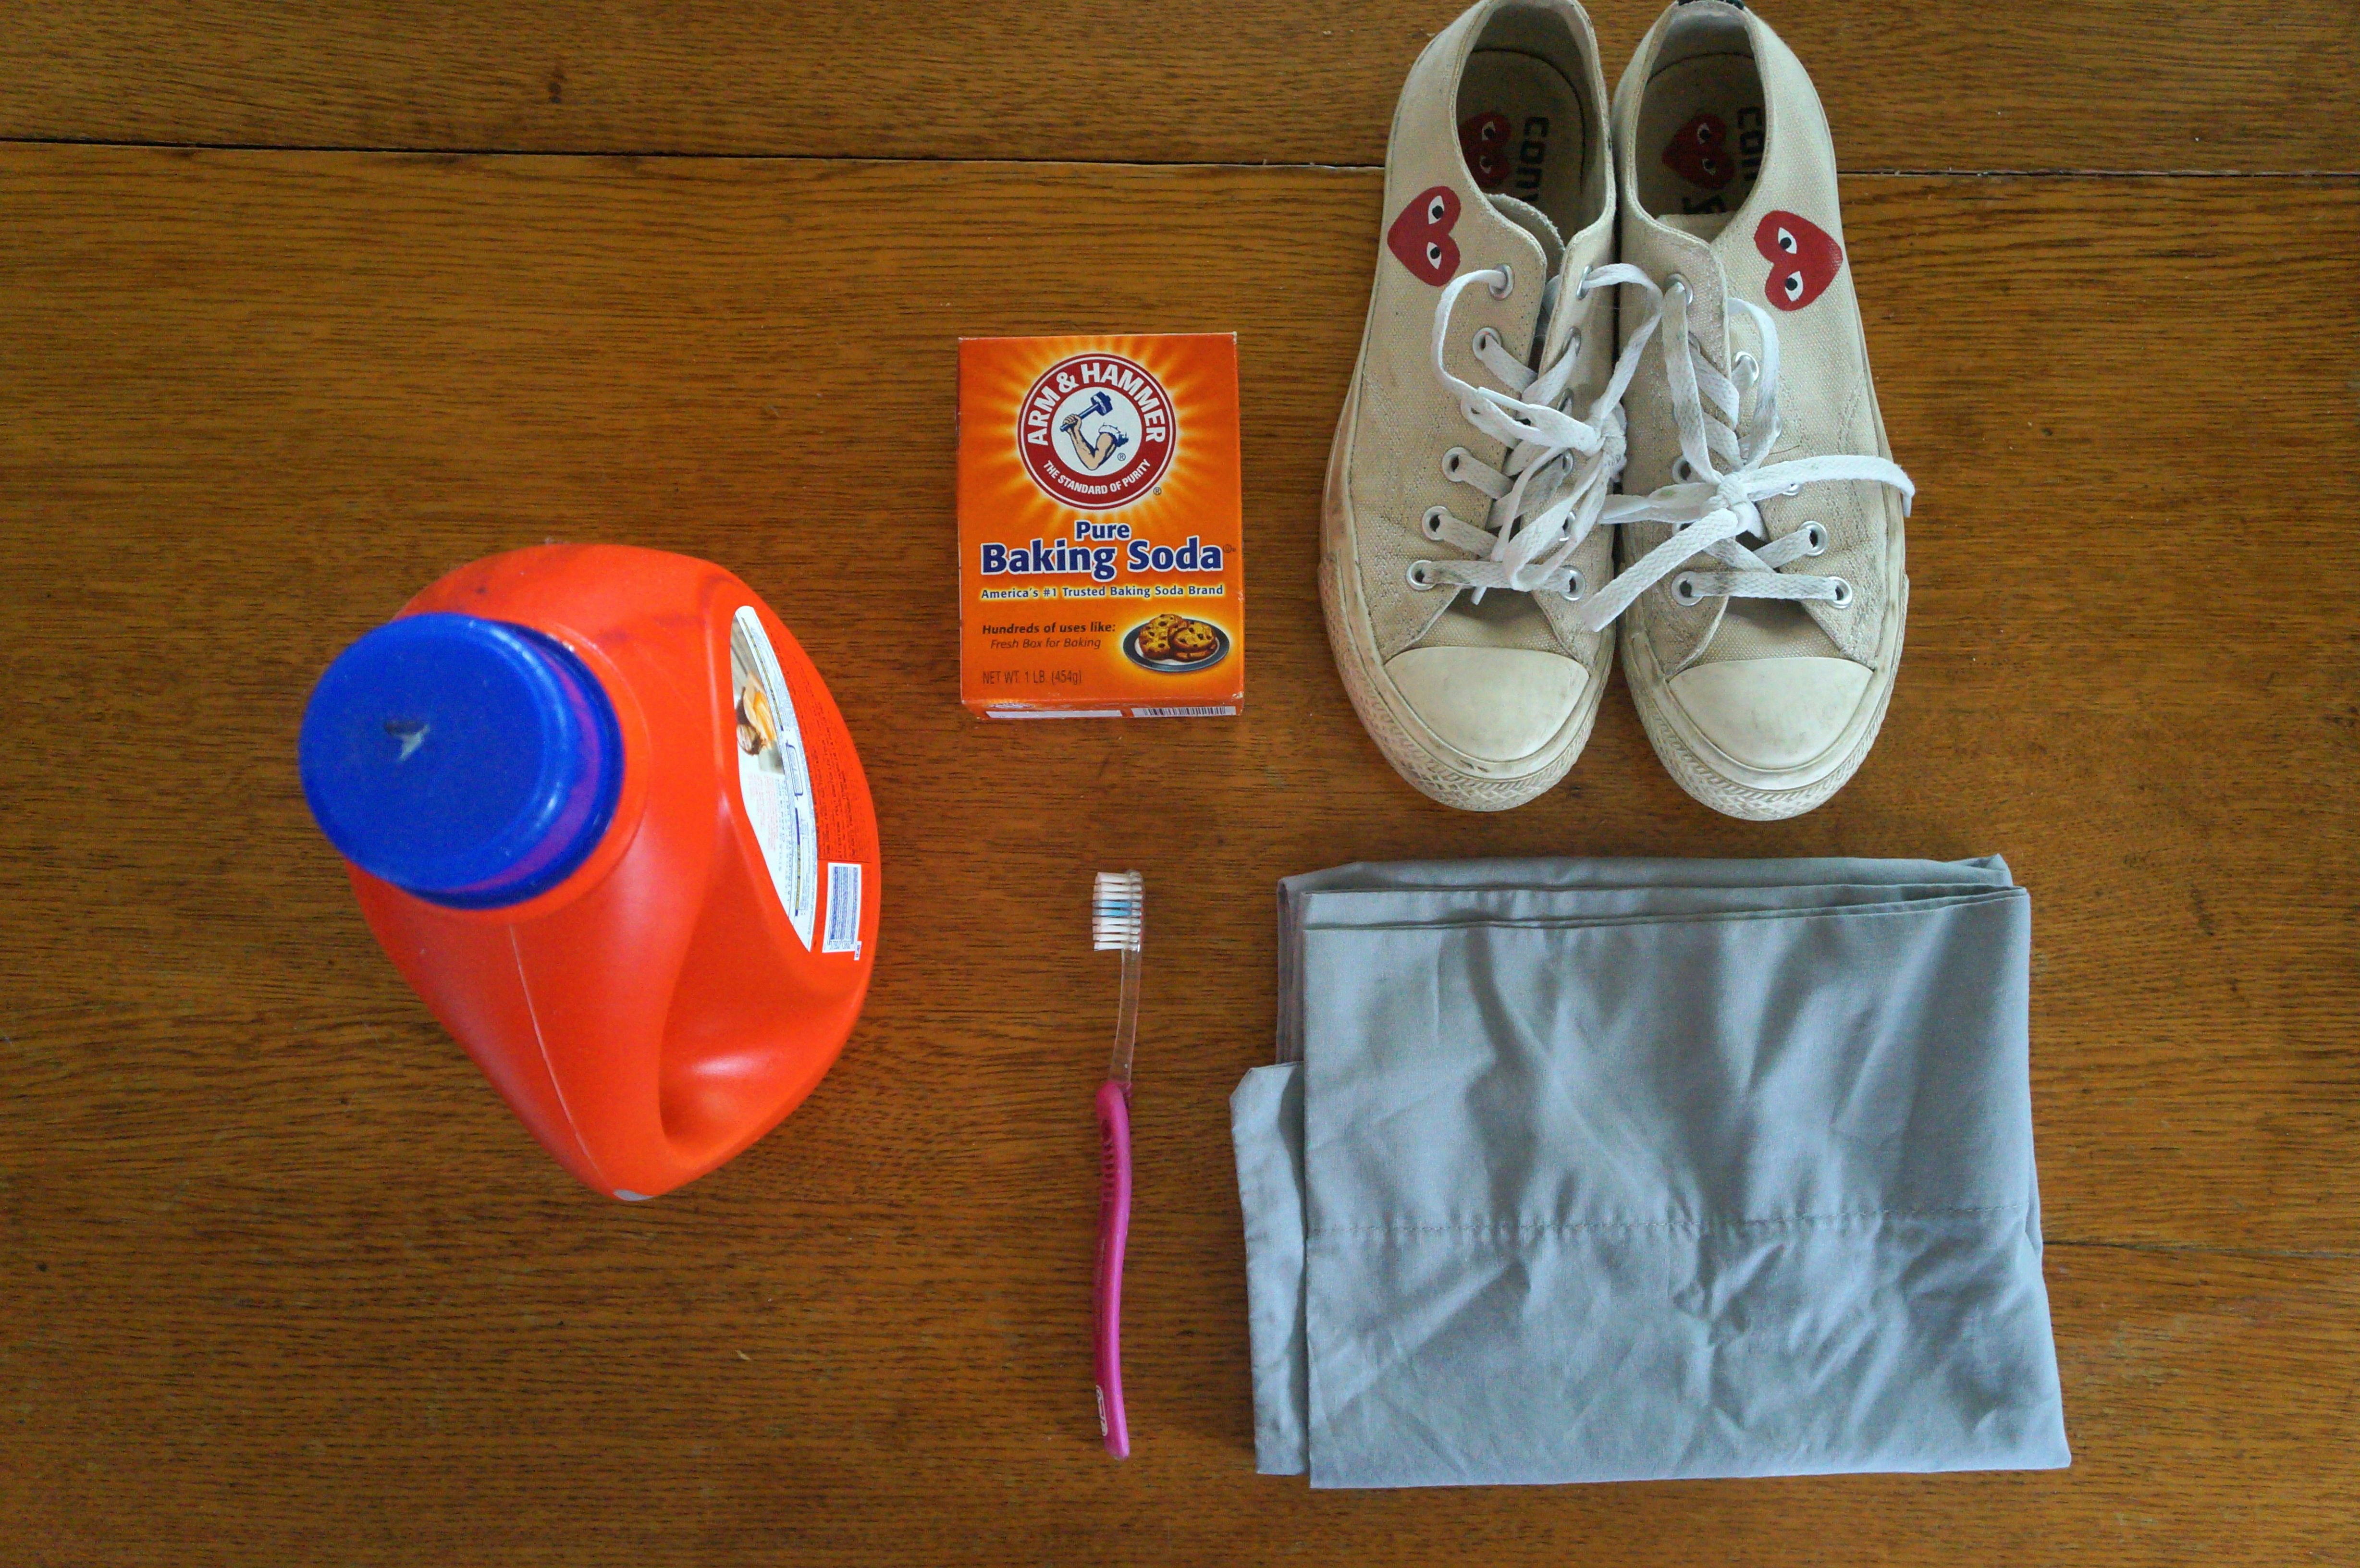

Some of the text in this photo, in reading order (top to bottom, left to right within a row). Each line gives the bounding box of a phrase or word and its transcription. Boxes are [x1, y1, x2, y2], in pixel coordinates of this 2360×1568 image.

[1028, 363, 1165, 445] ARM & HAMMER
[1044, 459, 1151, 495] THE STANDARD OF PURITY
[1074, 520, 1131, 541] Pure
[981, 536, 1223, 582] Baking Soda
[982, 585, 1223, 598] America's #1 Trusted Baking Soda Brand
[983, 622, 1116, 634] Hundreds of uses like:
[991, 637, 1100, 649] Fresh Box for Baking
[983, 670, 1082, 685] NET WT. 1 LB (454g)
